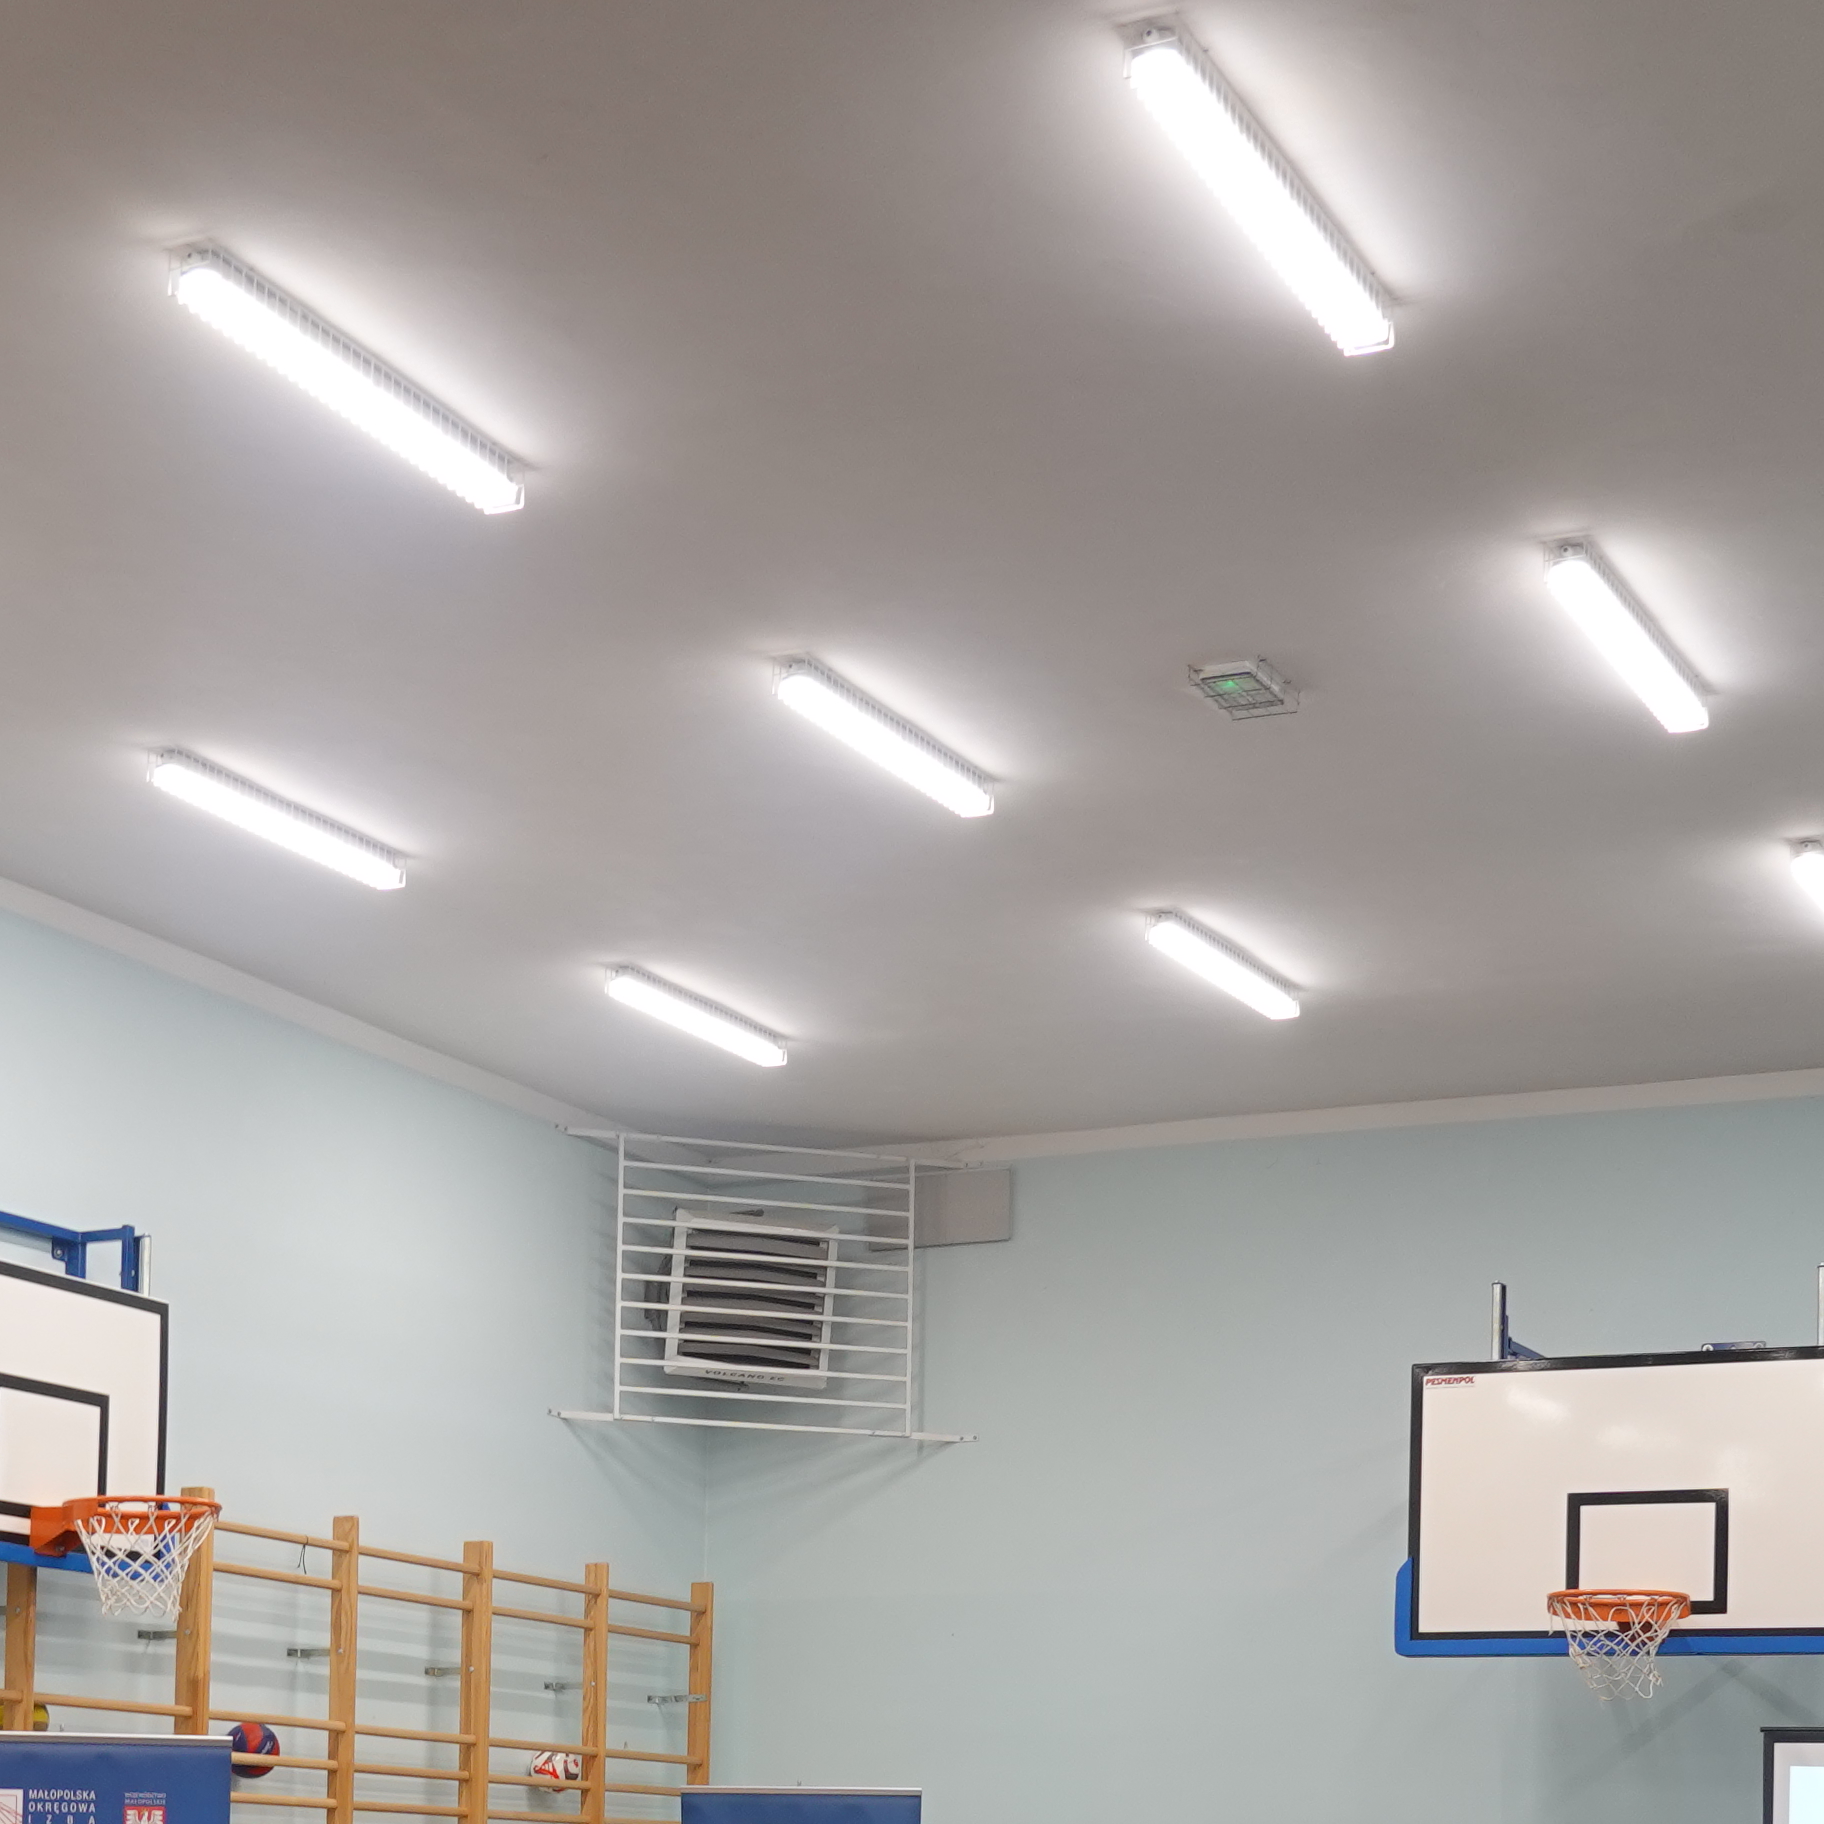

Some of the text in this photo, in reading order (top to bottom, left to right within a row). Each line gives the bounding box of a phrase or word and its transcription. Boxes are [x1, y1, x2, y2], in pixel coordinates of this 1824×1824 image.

[705, 1369, 765, 1380] VOLCANO
[28, 1789, 96, 1800] MAŁOPOLSKA
[28, 1801, 96, 1814] OKRĘGOWA
